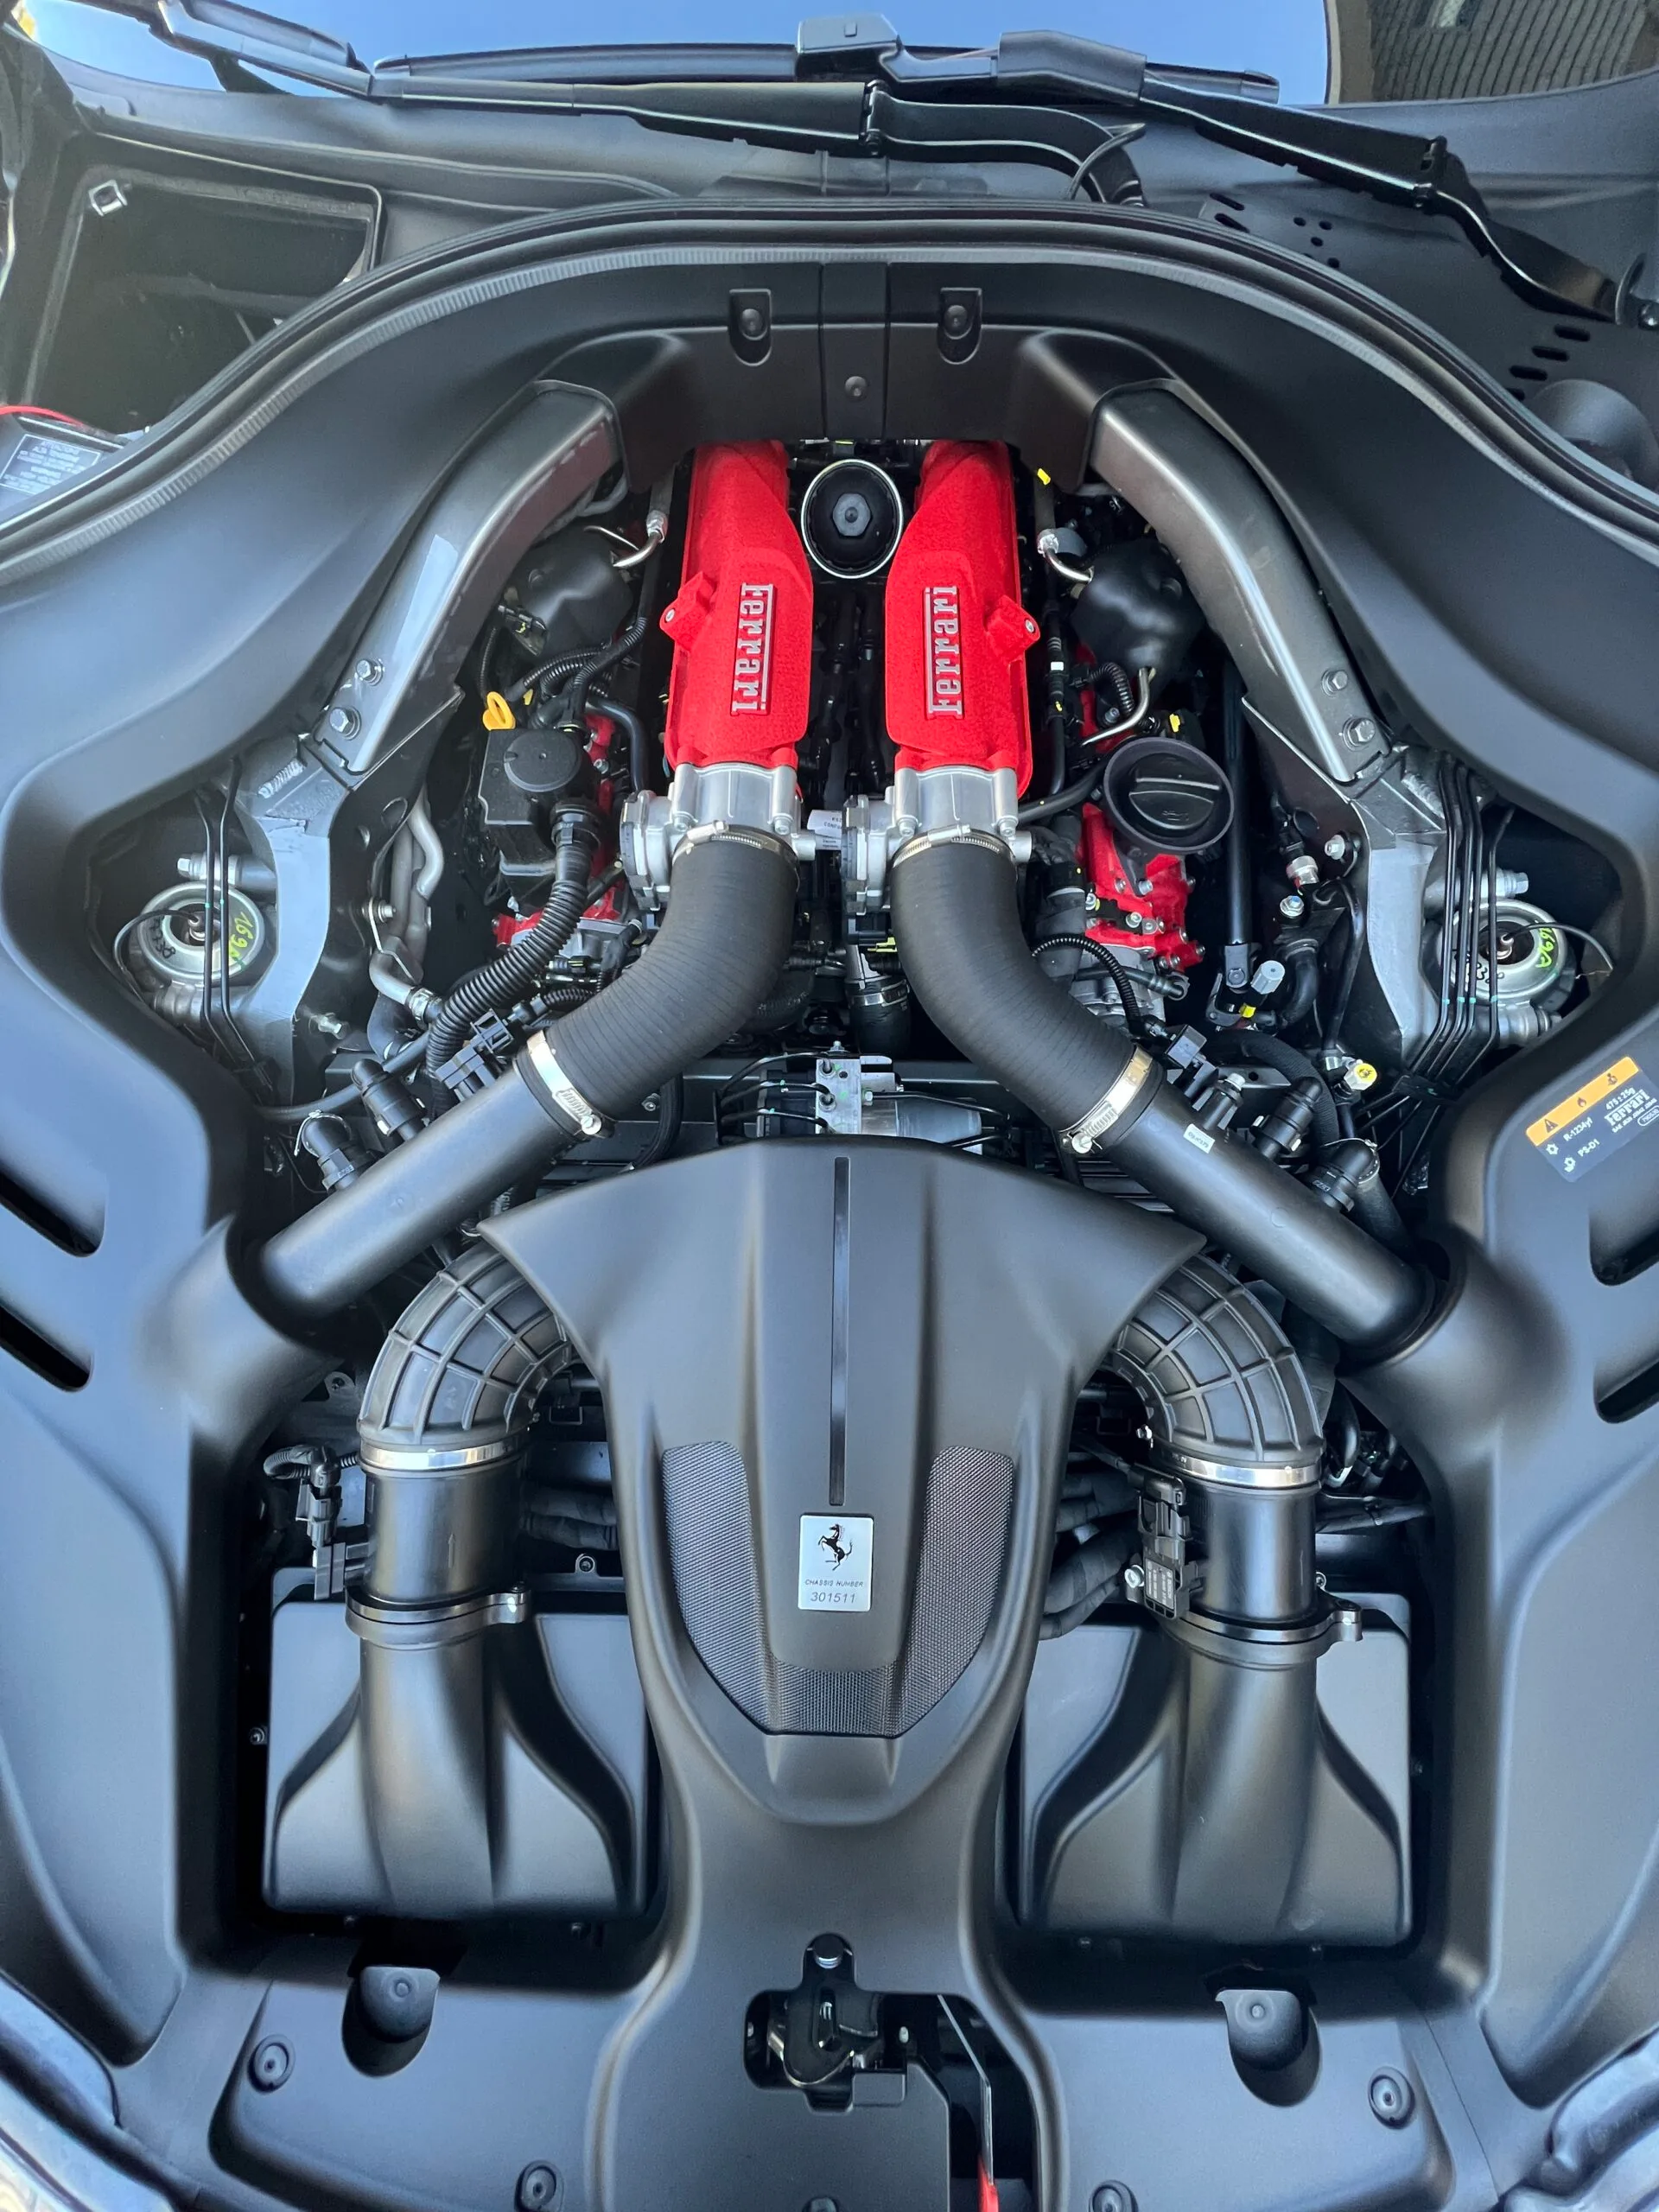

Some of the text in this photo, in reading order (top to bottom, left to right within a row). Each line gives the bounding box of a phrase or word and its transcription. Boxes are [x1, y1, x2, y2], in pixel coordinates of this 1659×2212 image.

[733, 582, 772, 711] Ferrari
[925, 586, 962, 715] Ferrari
[1605, 1090, 1649, 1126] Ferrari
[1563, 1116, 1593, 1141] R-1234yf
[805, 1579, 834, 1587] CHASSIS
[810, 1592, 855, 1604] 301511
